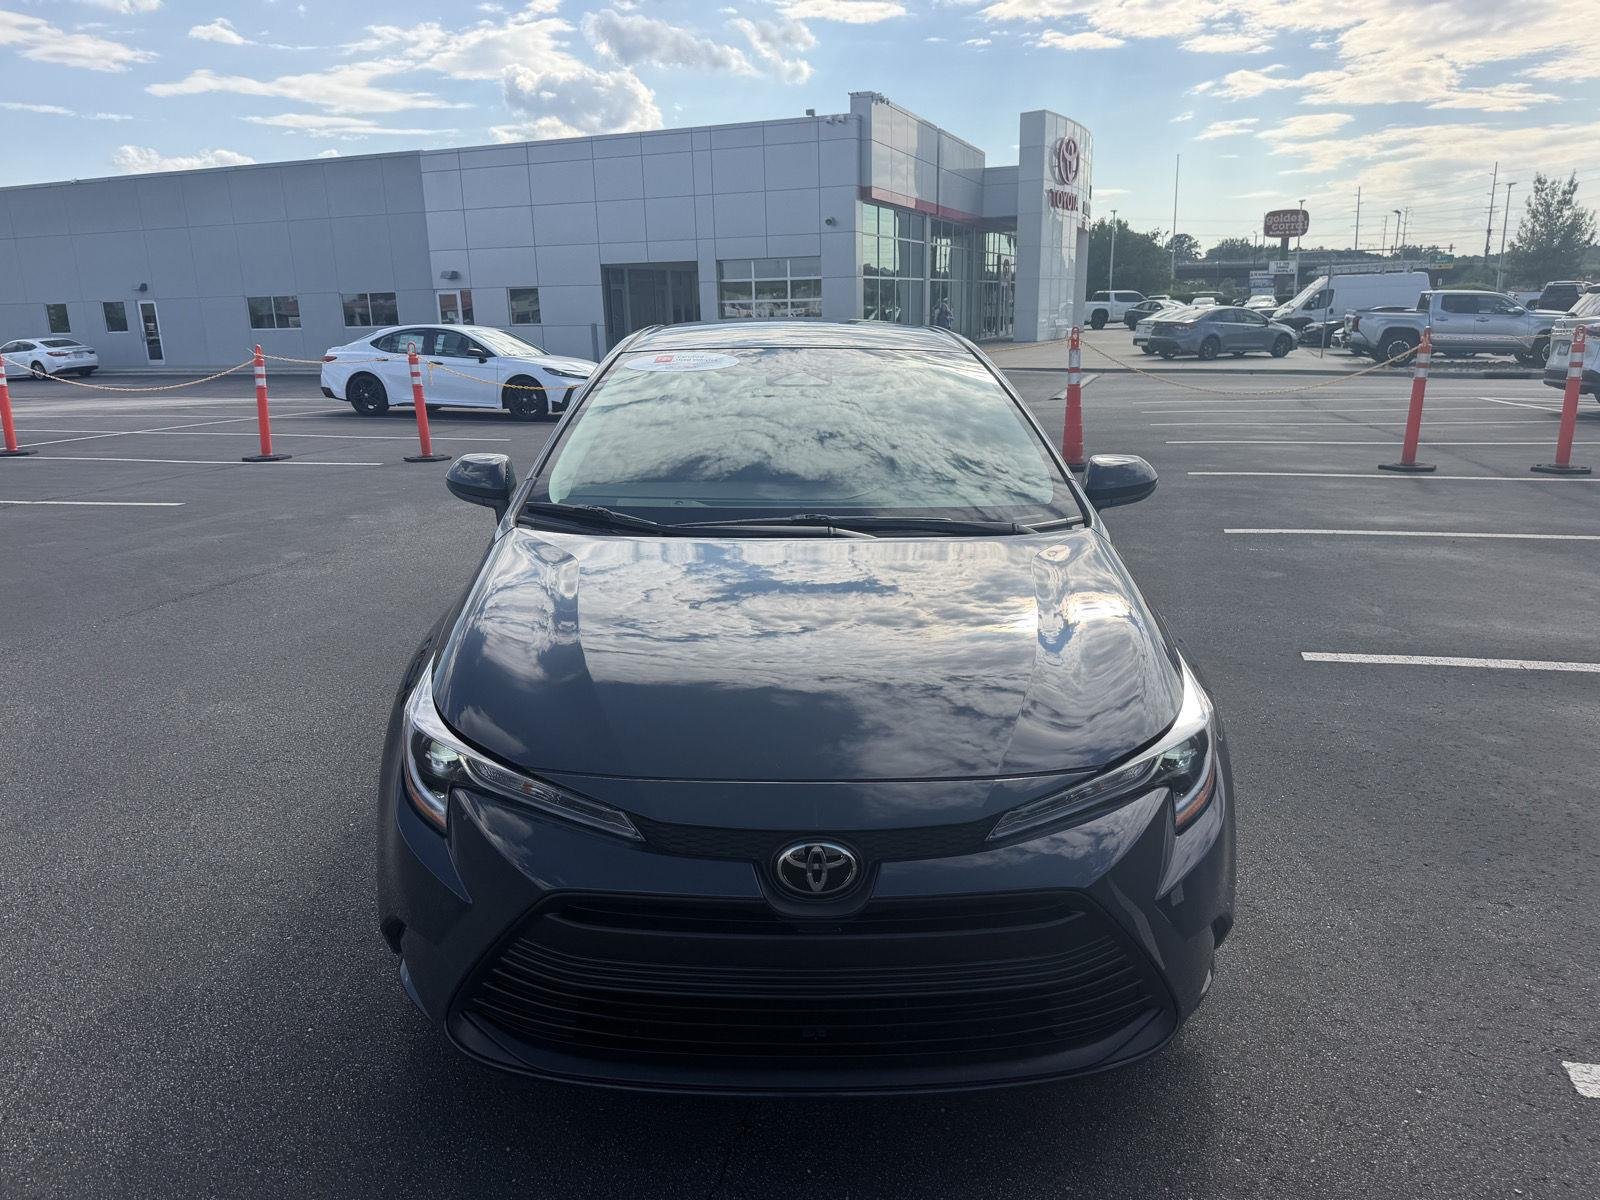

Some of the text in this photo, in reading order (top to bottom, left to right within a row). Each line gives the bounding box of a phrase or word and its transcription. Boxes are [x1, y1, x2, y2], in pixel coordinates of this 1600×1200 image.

[1048, 189, 1078, 211] TOYOTA
[1266, 213, 1304, 225] golden
[1271, 220, 1308, 231] corral
